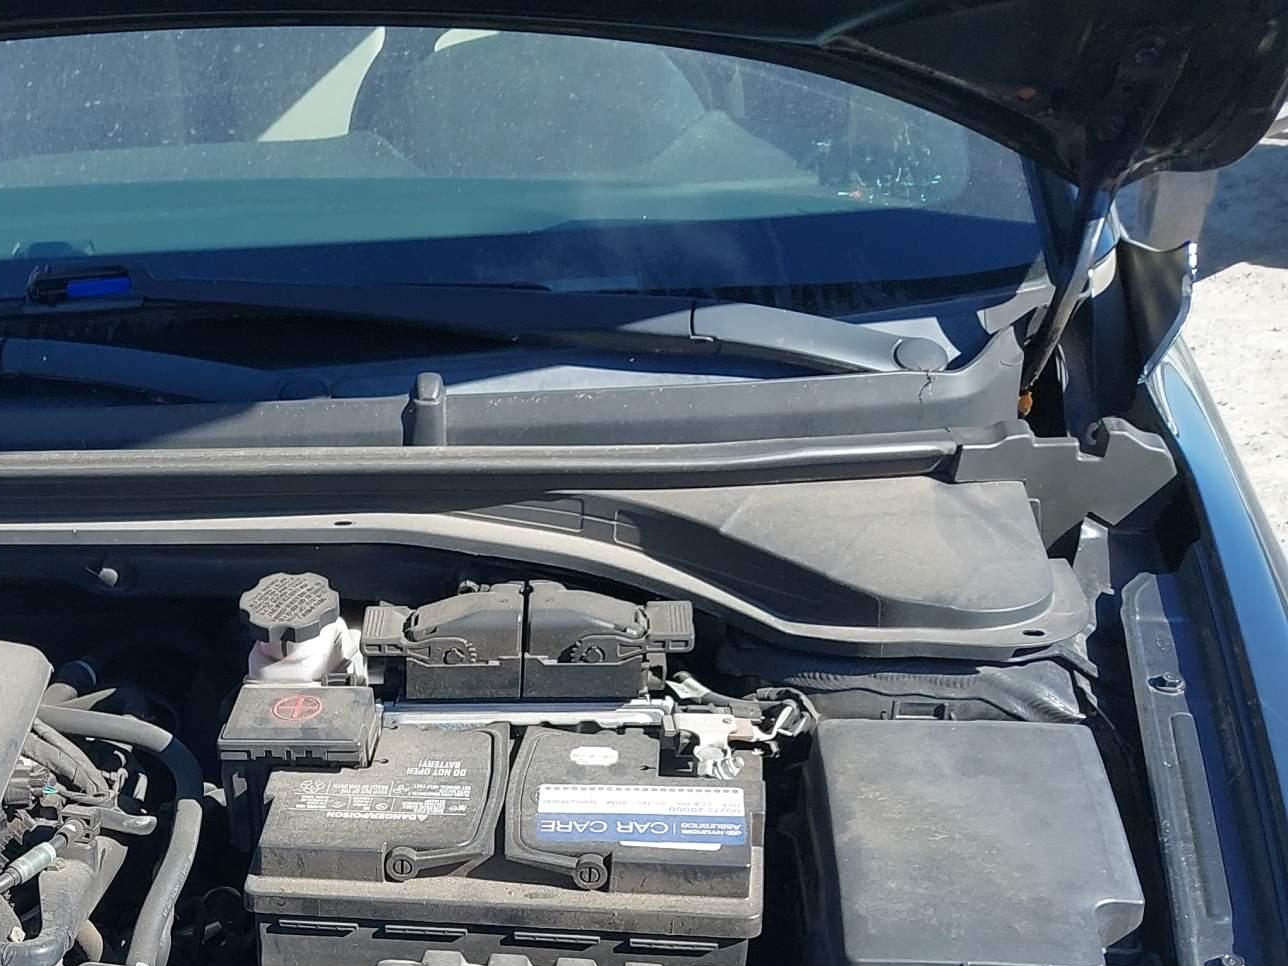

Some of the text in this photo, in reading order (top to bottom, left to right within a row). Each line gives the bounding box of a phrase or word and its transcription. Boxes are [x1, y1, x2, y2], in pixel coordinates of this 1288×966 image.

[418, 759, 461, 769] BATTERY!
[406, 767, 467, 777] DO NOT OPEN
[540, 819, 669, 835] CAR CARE
